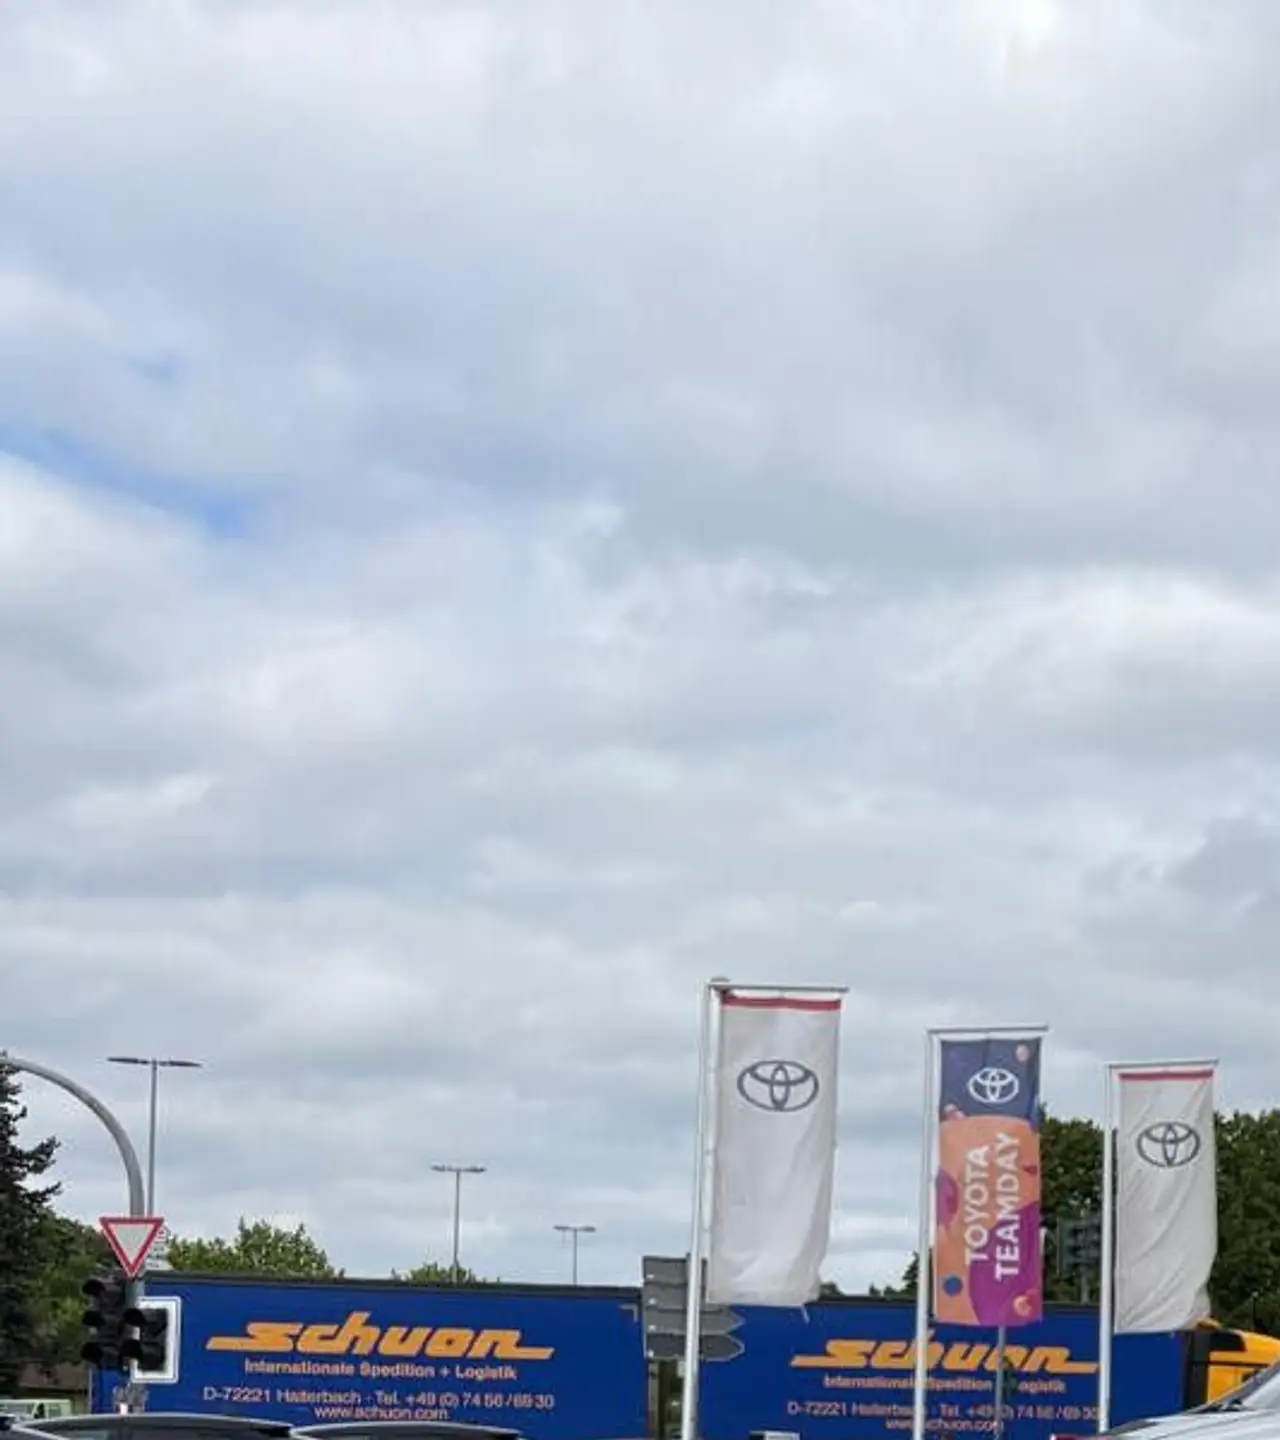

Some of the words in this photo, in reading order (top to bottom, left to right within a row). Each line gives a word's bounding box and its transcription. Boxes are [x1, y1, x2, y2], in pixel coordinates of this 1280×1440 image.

[963, 1143, 990, 1265] TOYOTA
[994, 1131, 1022, 1282] TEAMDAY
[203, 1386, 271, 1403] D-72221
[244, 1357, 355, 1375] Internationale
[359, 1361, 436, 1379] Spedition
[455, 1364, 518, 1382] Logistik
